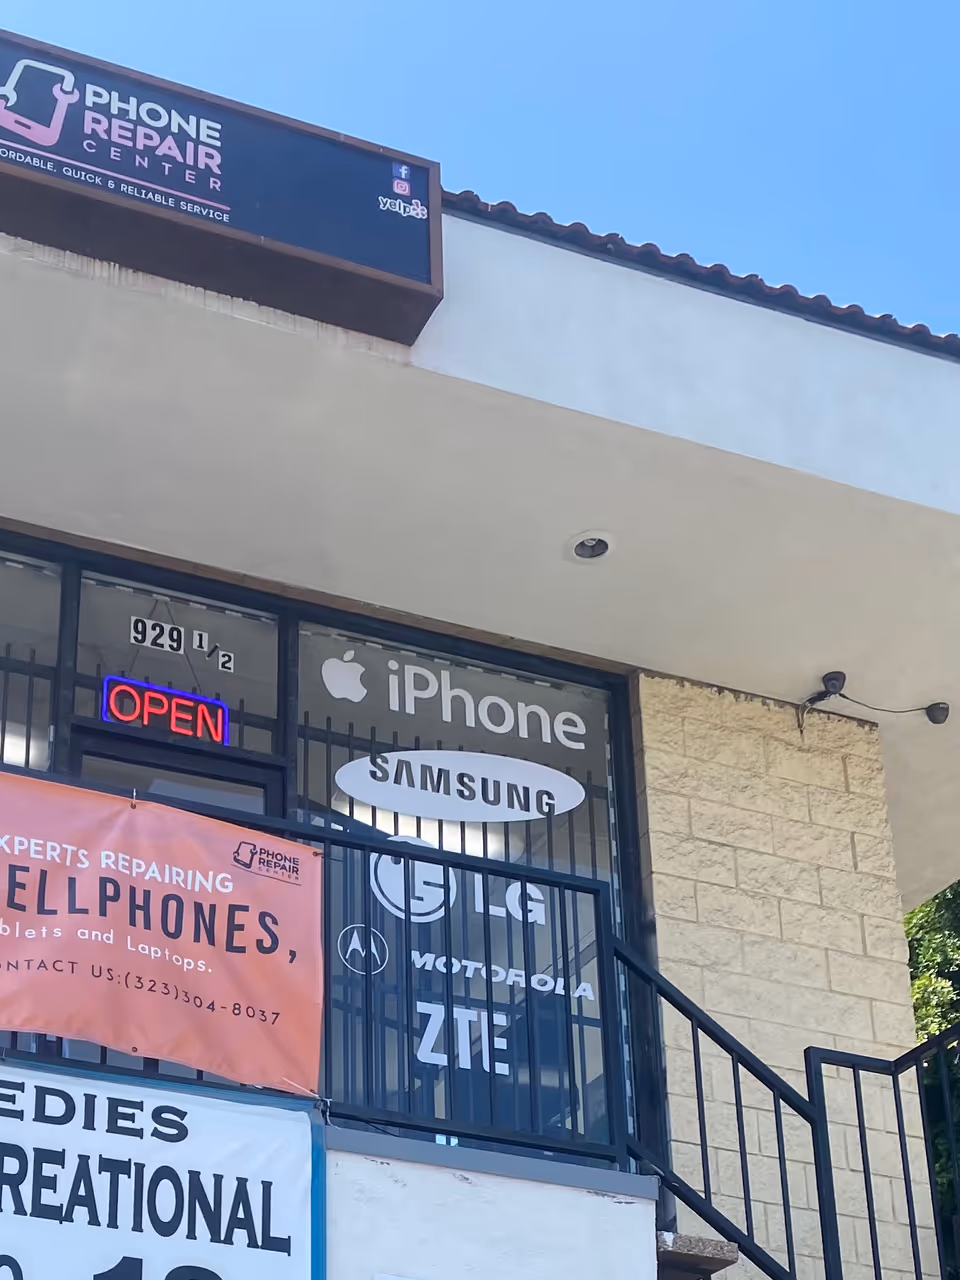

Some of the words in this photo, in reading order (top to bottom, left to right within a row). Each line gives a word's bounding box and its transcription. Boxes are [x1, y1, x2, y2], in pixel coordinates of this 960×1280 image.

[85, 83, 222, 147] PHONE
[83, 109, 222, 175] REPAIR
[83, 139, 222, 192] CENTER
[63, 167, 102, 185] QUICK
[107, 180, 115, 189] &
[120, 184, 175, 207] RELIABLE
[180, 201, 230, 223] SERVICE
[378, 196, 413, 217] yelp
[132, 618, 183, 652] 929
[109, 684, 223, 743] OPEN
[387, 659, 586, 750] iPhone
[369, 753, 556, 816] SAMSUNG
[101, 850, 234, 894] REPAIRING
[258, 857, 299, 876] REPAIR
[259, 847, 300, 866] PHONE
[474, 872, 546, 926] LG
[77, 926, 114, 945] and
[127, 935, 213, 974] Laptops.
[411, 950, 595, 1001] MOTOROLA
[416, 1001, 510, 1076] ZTE
